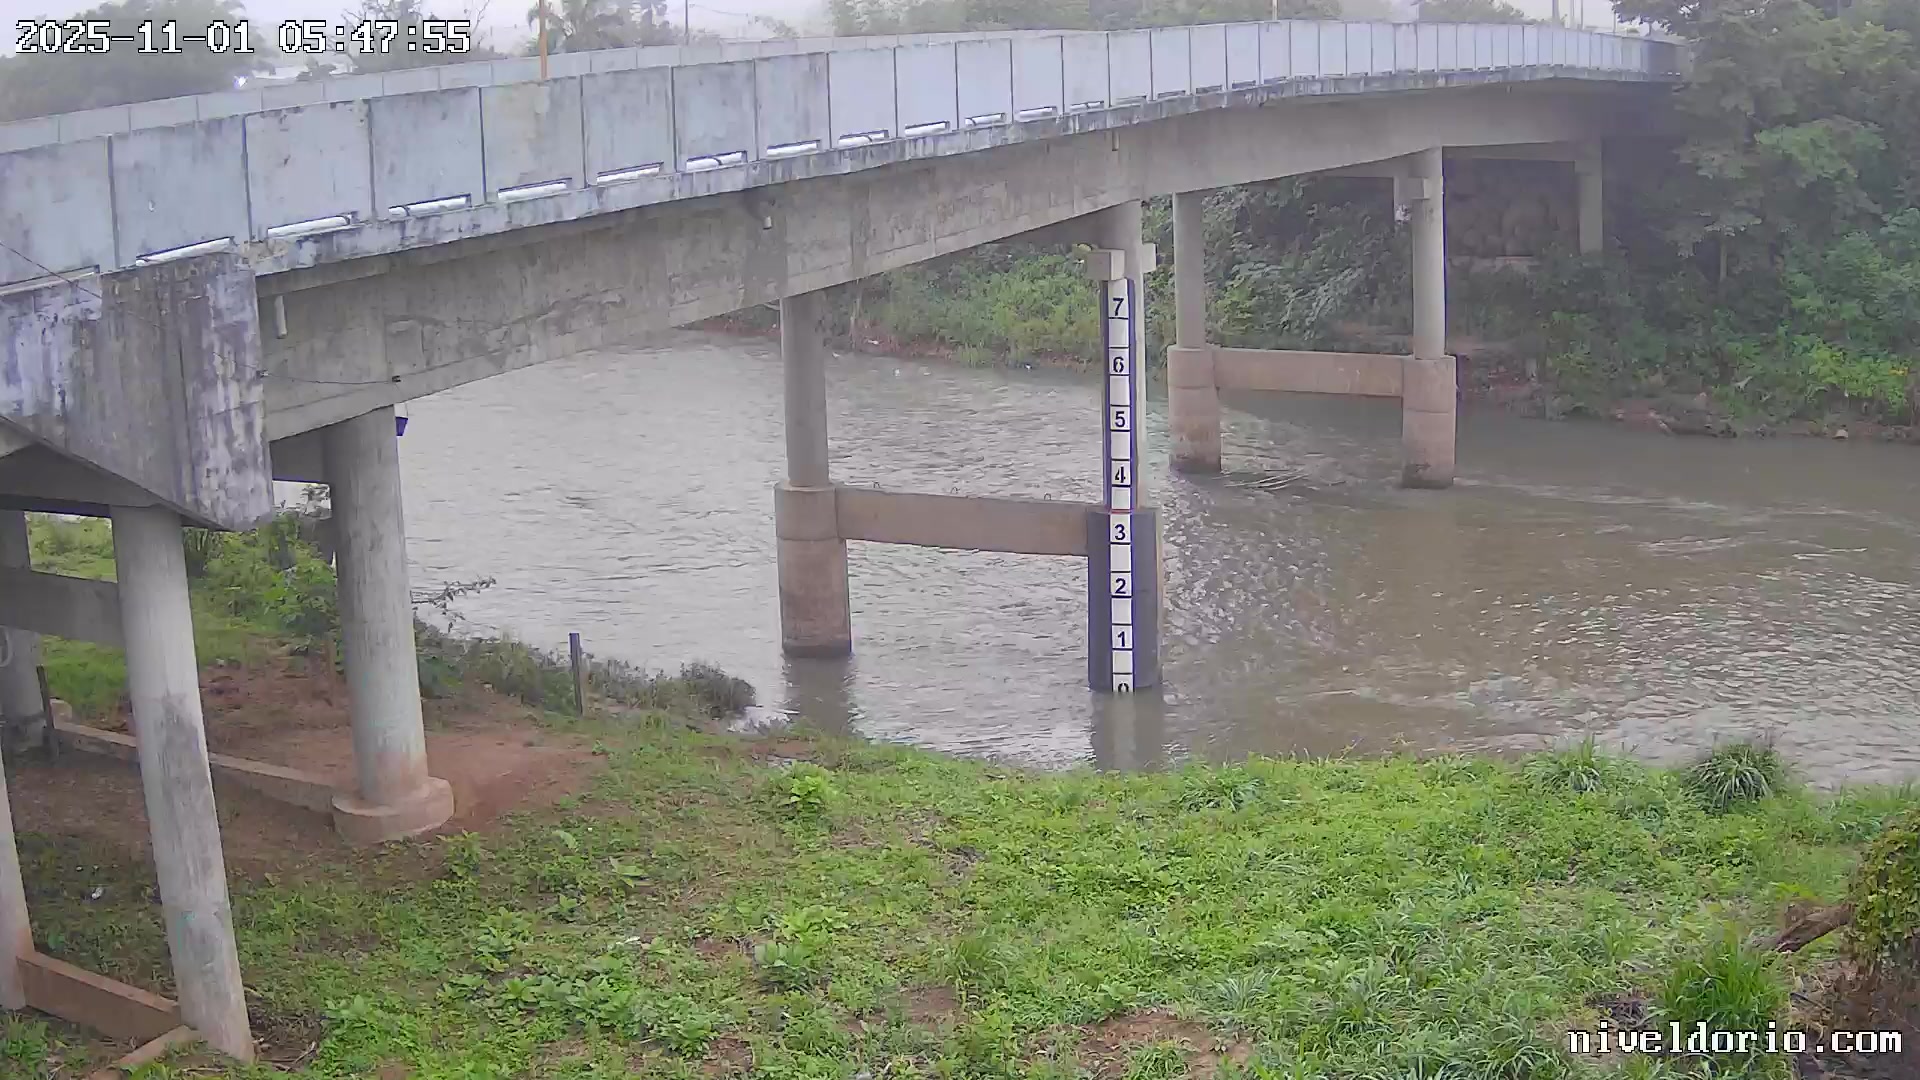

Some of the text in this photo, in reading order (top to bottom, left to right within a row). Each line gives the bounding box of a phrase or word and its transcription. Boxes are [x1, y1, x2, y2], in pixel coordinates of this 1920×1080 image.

[1113, 298, 1124, 316] 7
[1113, 356, 1124, 373] 6
[1115, 411, 1126, 428] 5
[1115, 466, 1126, 483] 4
[1115, 524, 1126, 541] 3
[1115, 578, 1126, 594] 2
[1117, 631, 1126, 647] 1
